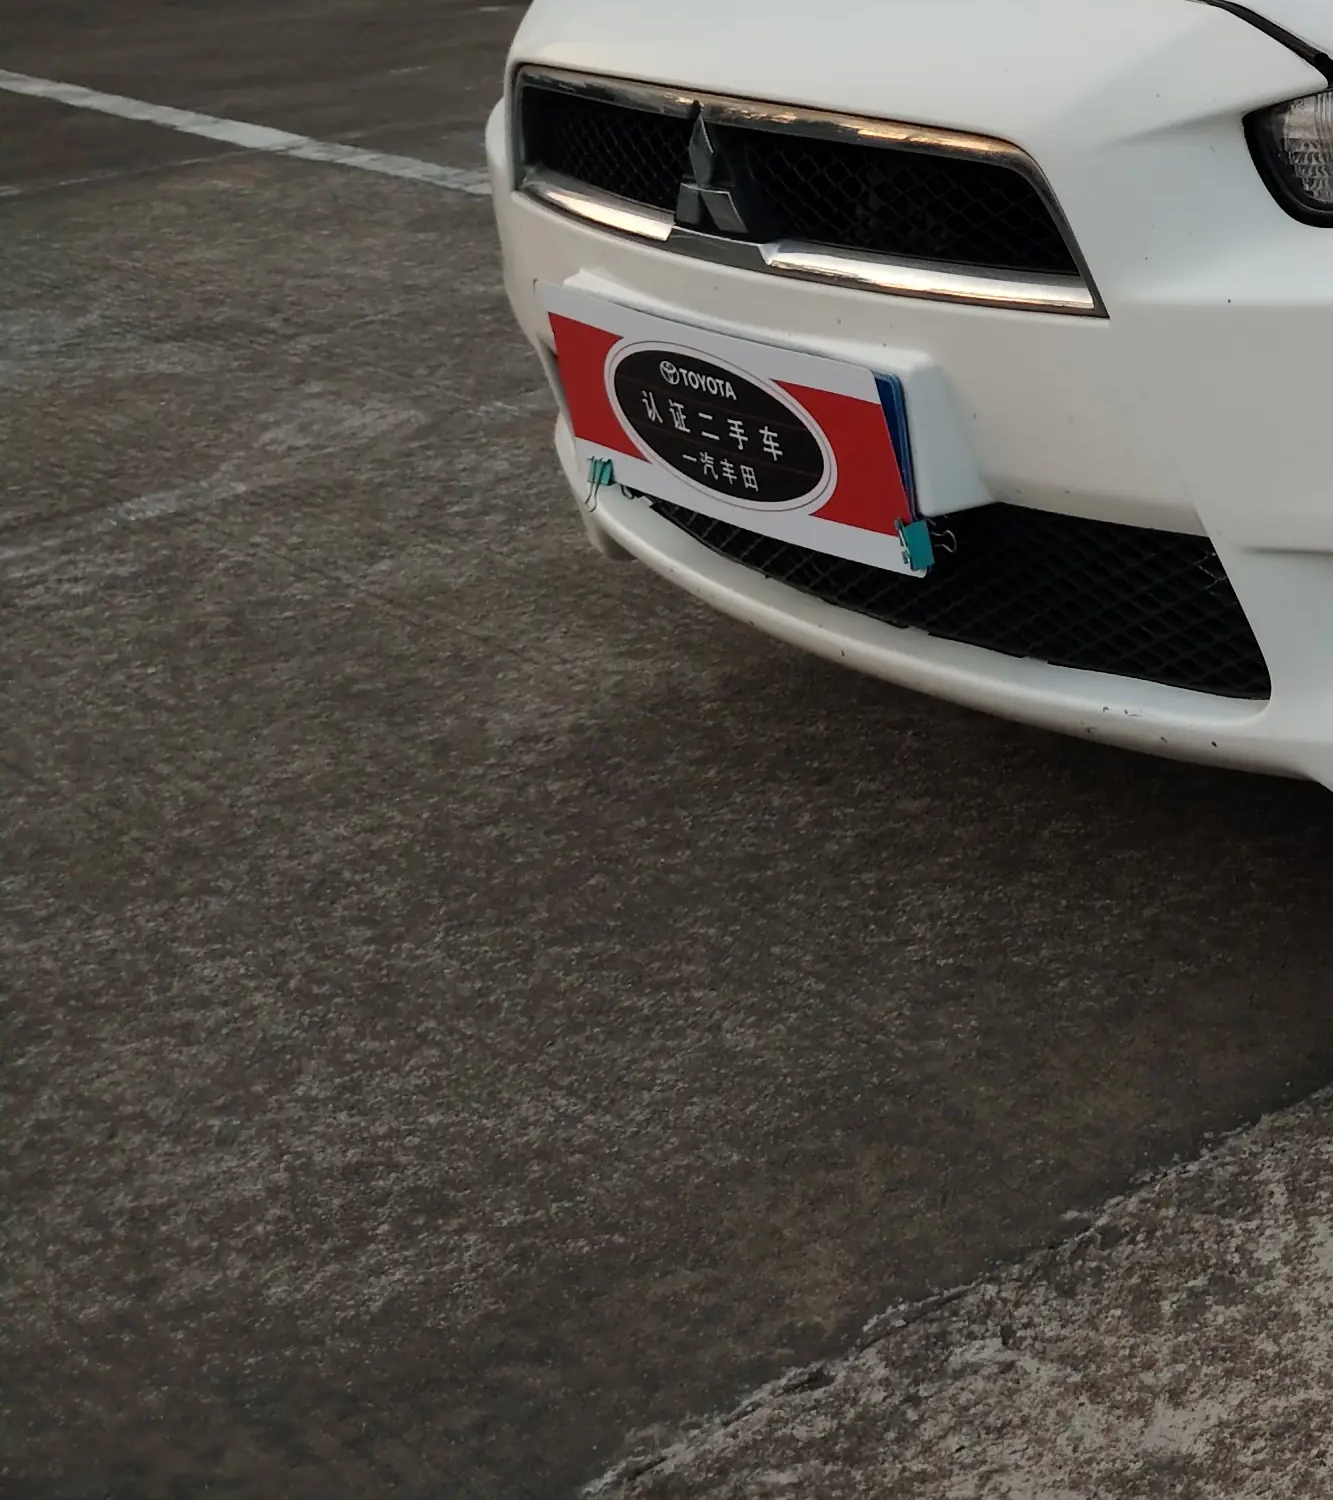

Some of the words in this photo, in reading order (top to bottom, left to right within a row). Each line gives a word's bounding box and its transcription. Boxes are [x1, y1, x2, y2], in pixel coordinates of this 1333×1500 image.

[679, 367, 738, 401] TOYOTA
[641, 390, 784, 462] 认证二手车
[681, 451, 759, 492] 一汽丰田
